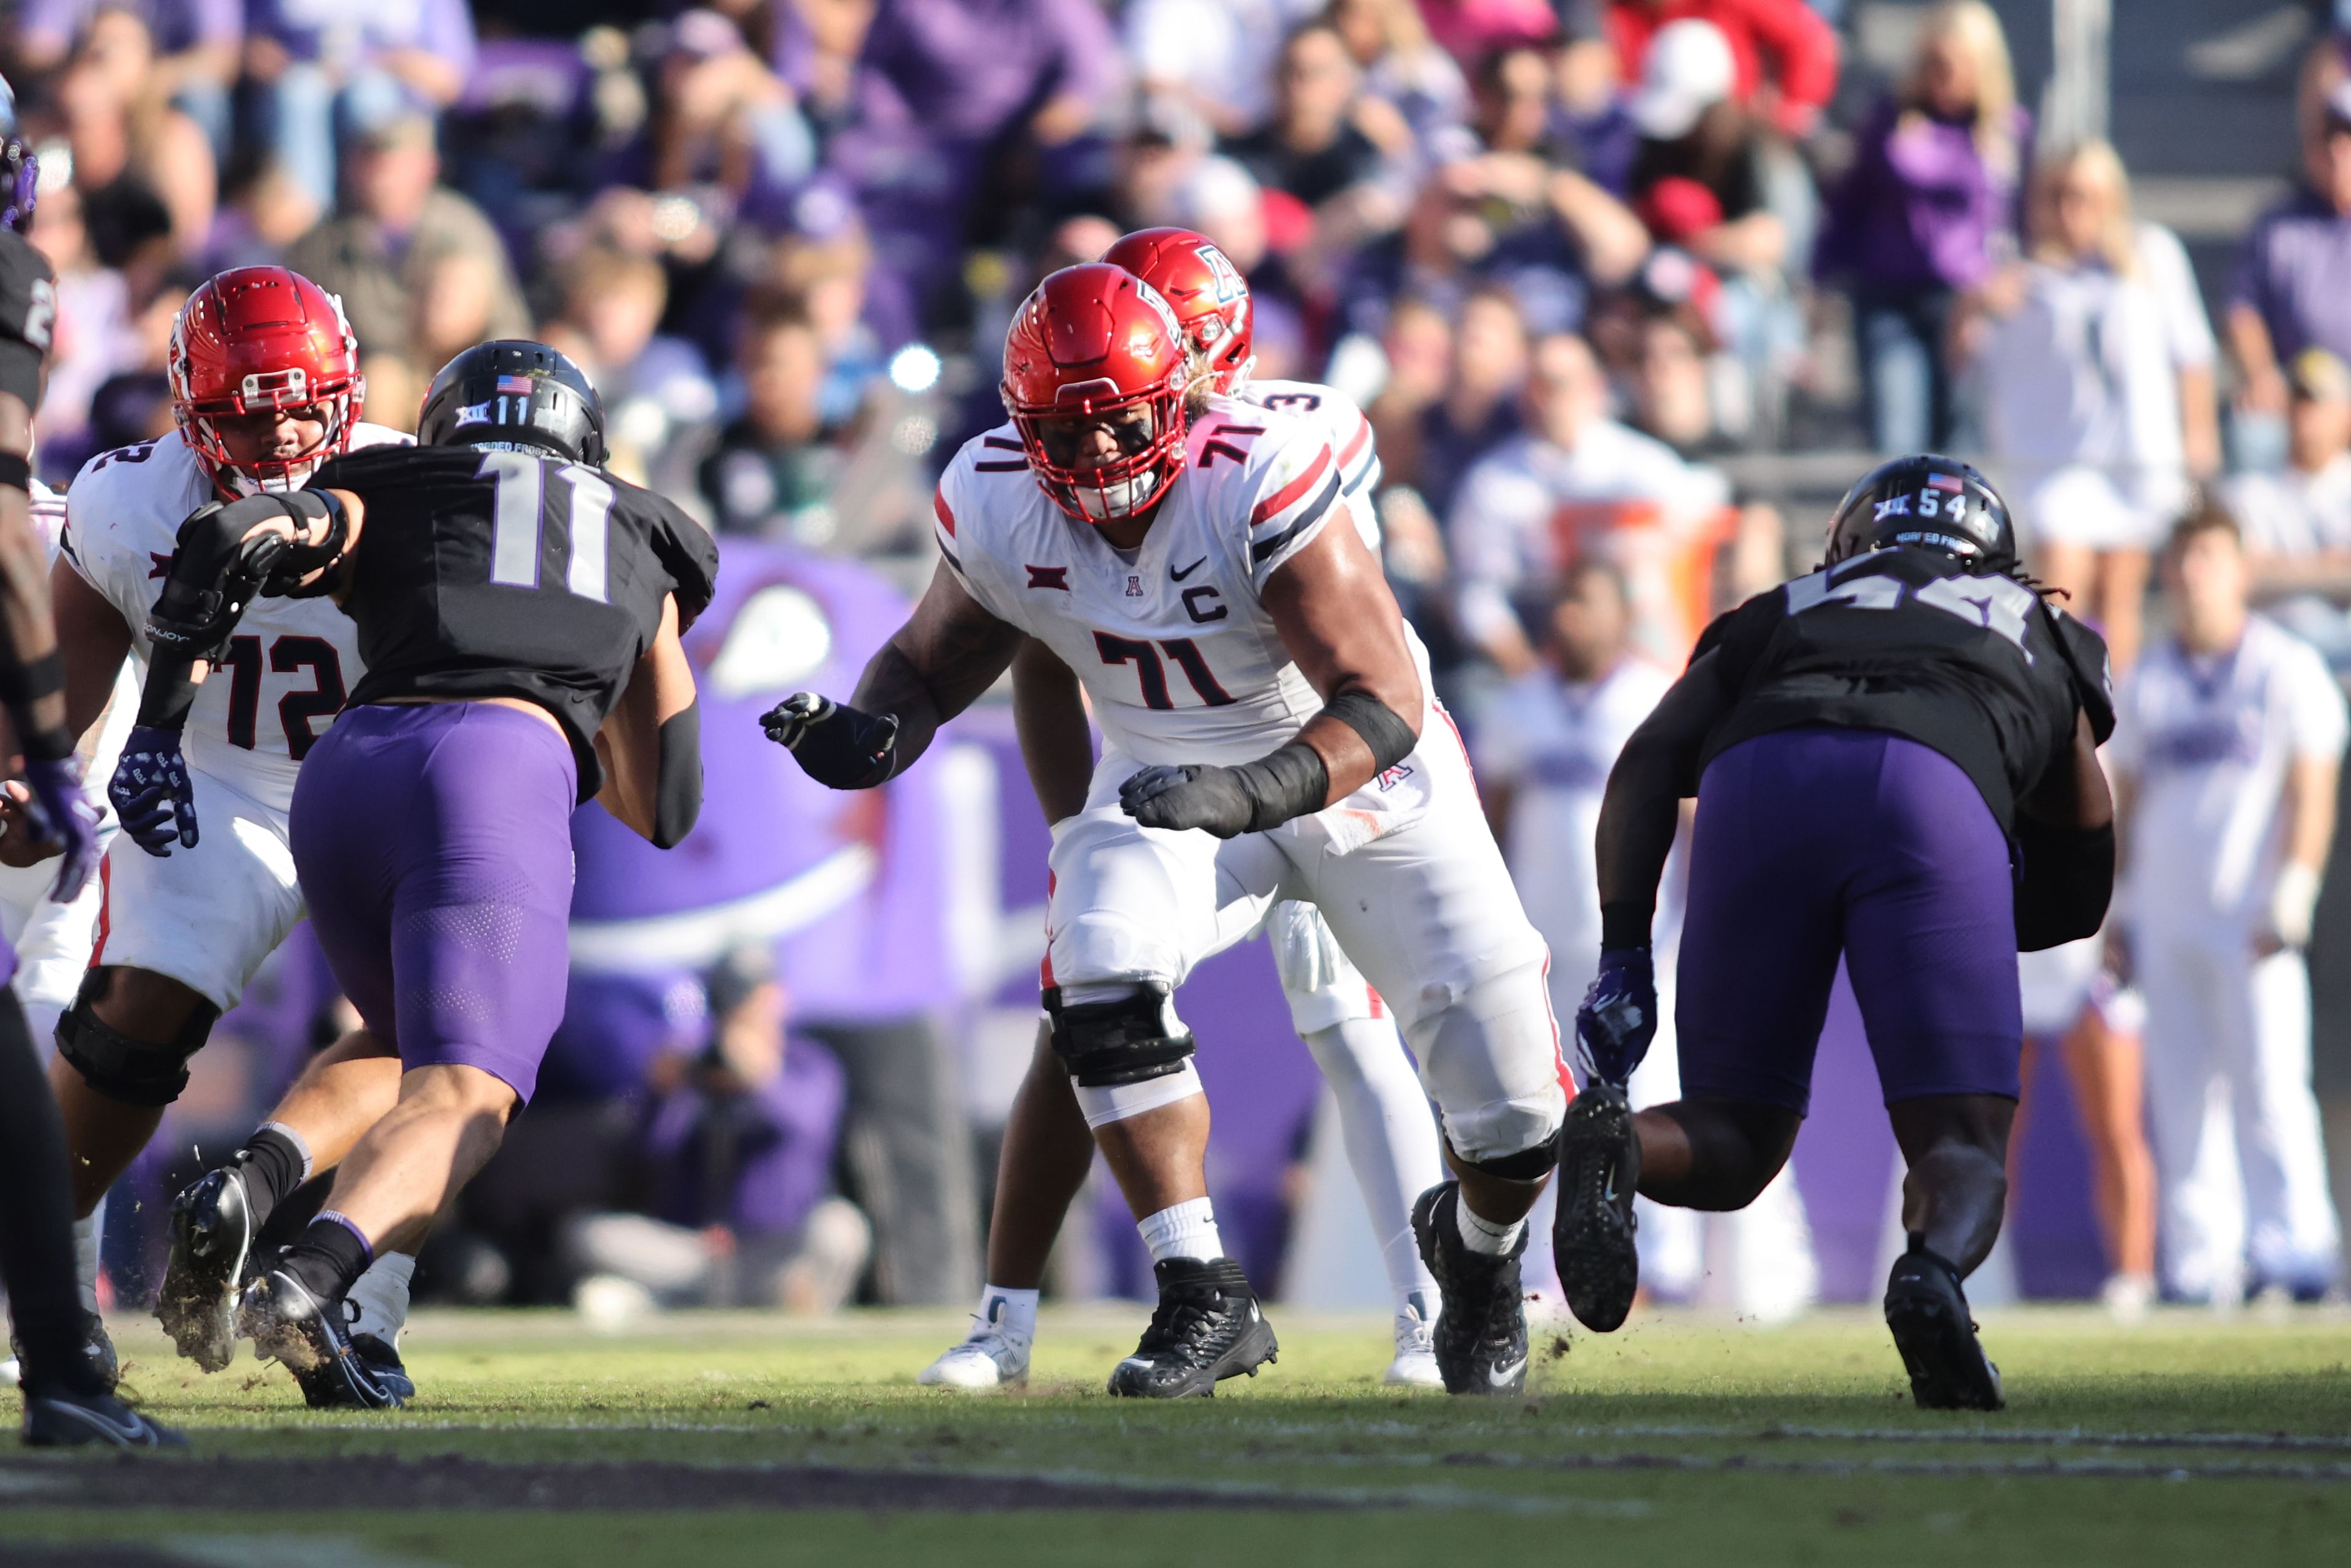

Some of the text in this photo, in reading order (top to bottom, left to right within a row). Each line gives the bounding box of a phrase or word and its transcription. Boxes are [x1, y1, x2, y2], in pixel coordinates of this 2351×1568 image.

[1193, 245, 1249, 304] A
[497, 395, 529, 426] 11
[1197, 424, 1267, 468] 71
[473, 450, 618, 605] 11
[1917, 488, 1966, 523] 54
[1126, 576, 1143, 597] A
[1181, 585, 1229, 623] C
[1092, 630, 1238, 710] 71
[213, 634, 348, 761] 72
